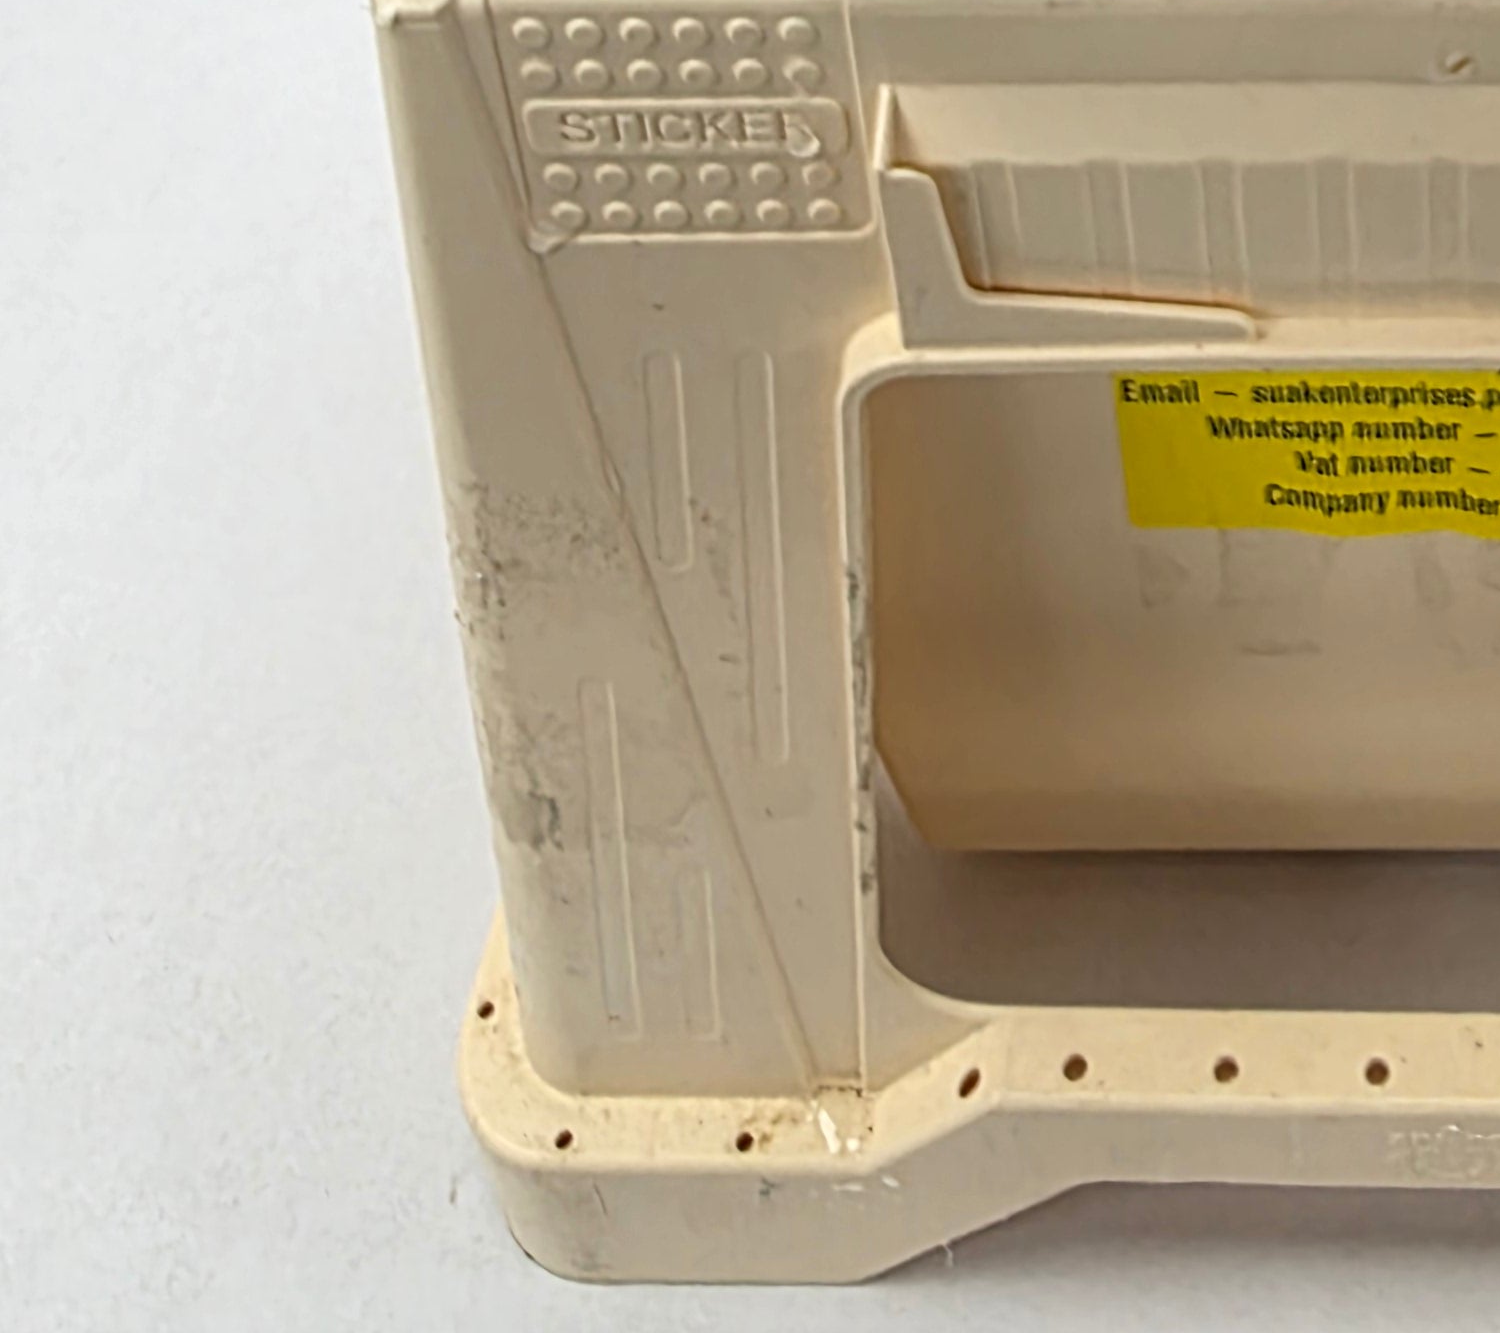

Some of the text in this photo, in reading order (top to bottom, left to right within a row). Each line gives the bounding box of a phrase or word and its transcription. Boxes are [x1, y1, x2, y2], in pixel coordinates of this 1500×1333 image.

[1121, 379, 1200, 403] Email
[1206, 415, 1344, 444] Whatsapp
[1351, 417, 1462, 441] number
[1294, 450, 1339, 476] Vat
[1346, 452, 1454, 475] number
[1264, 483, 1389, 516] Company
[1396, 488, 1500, 515] number
